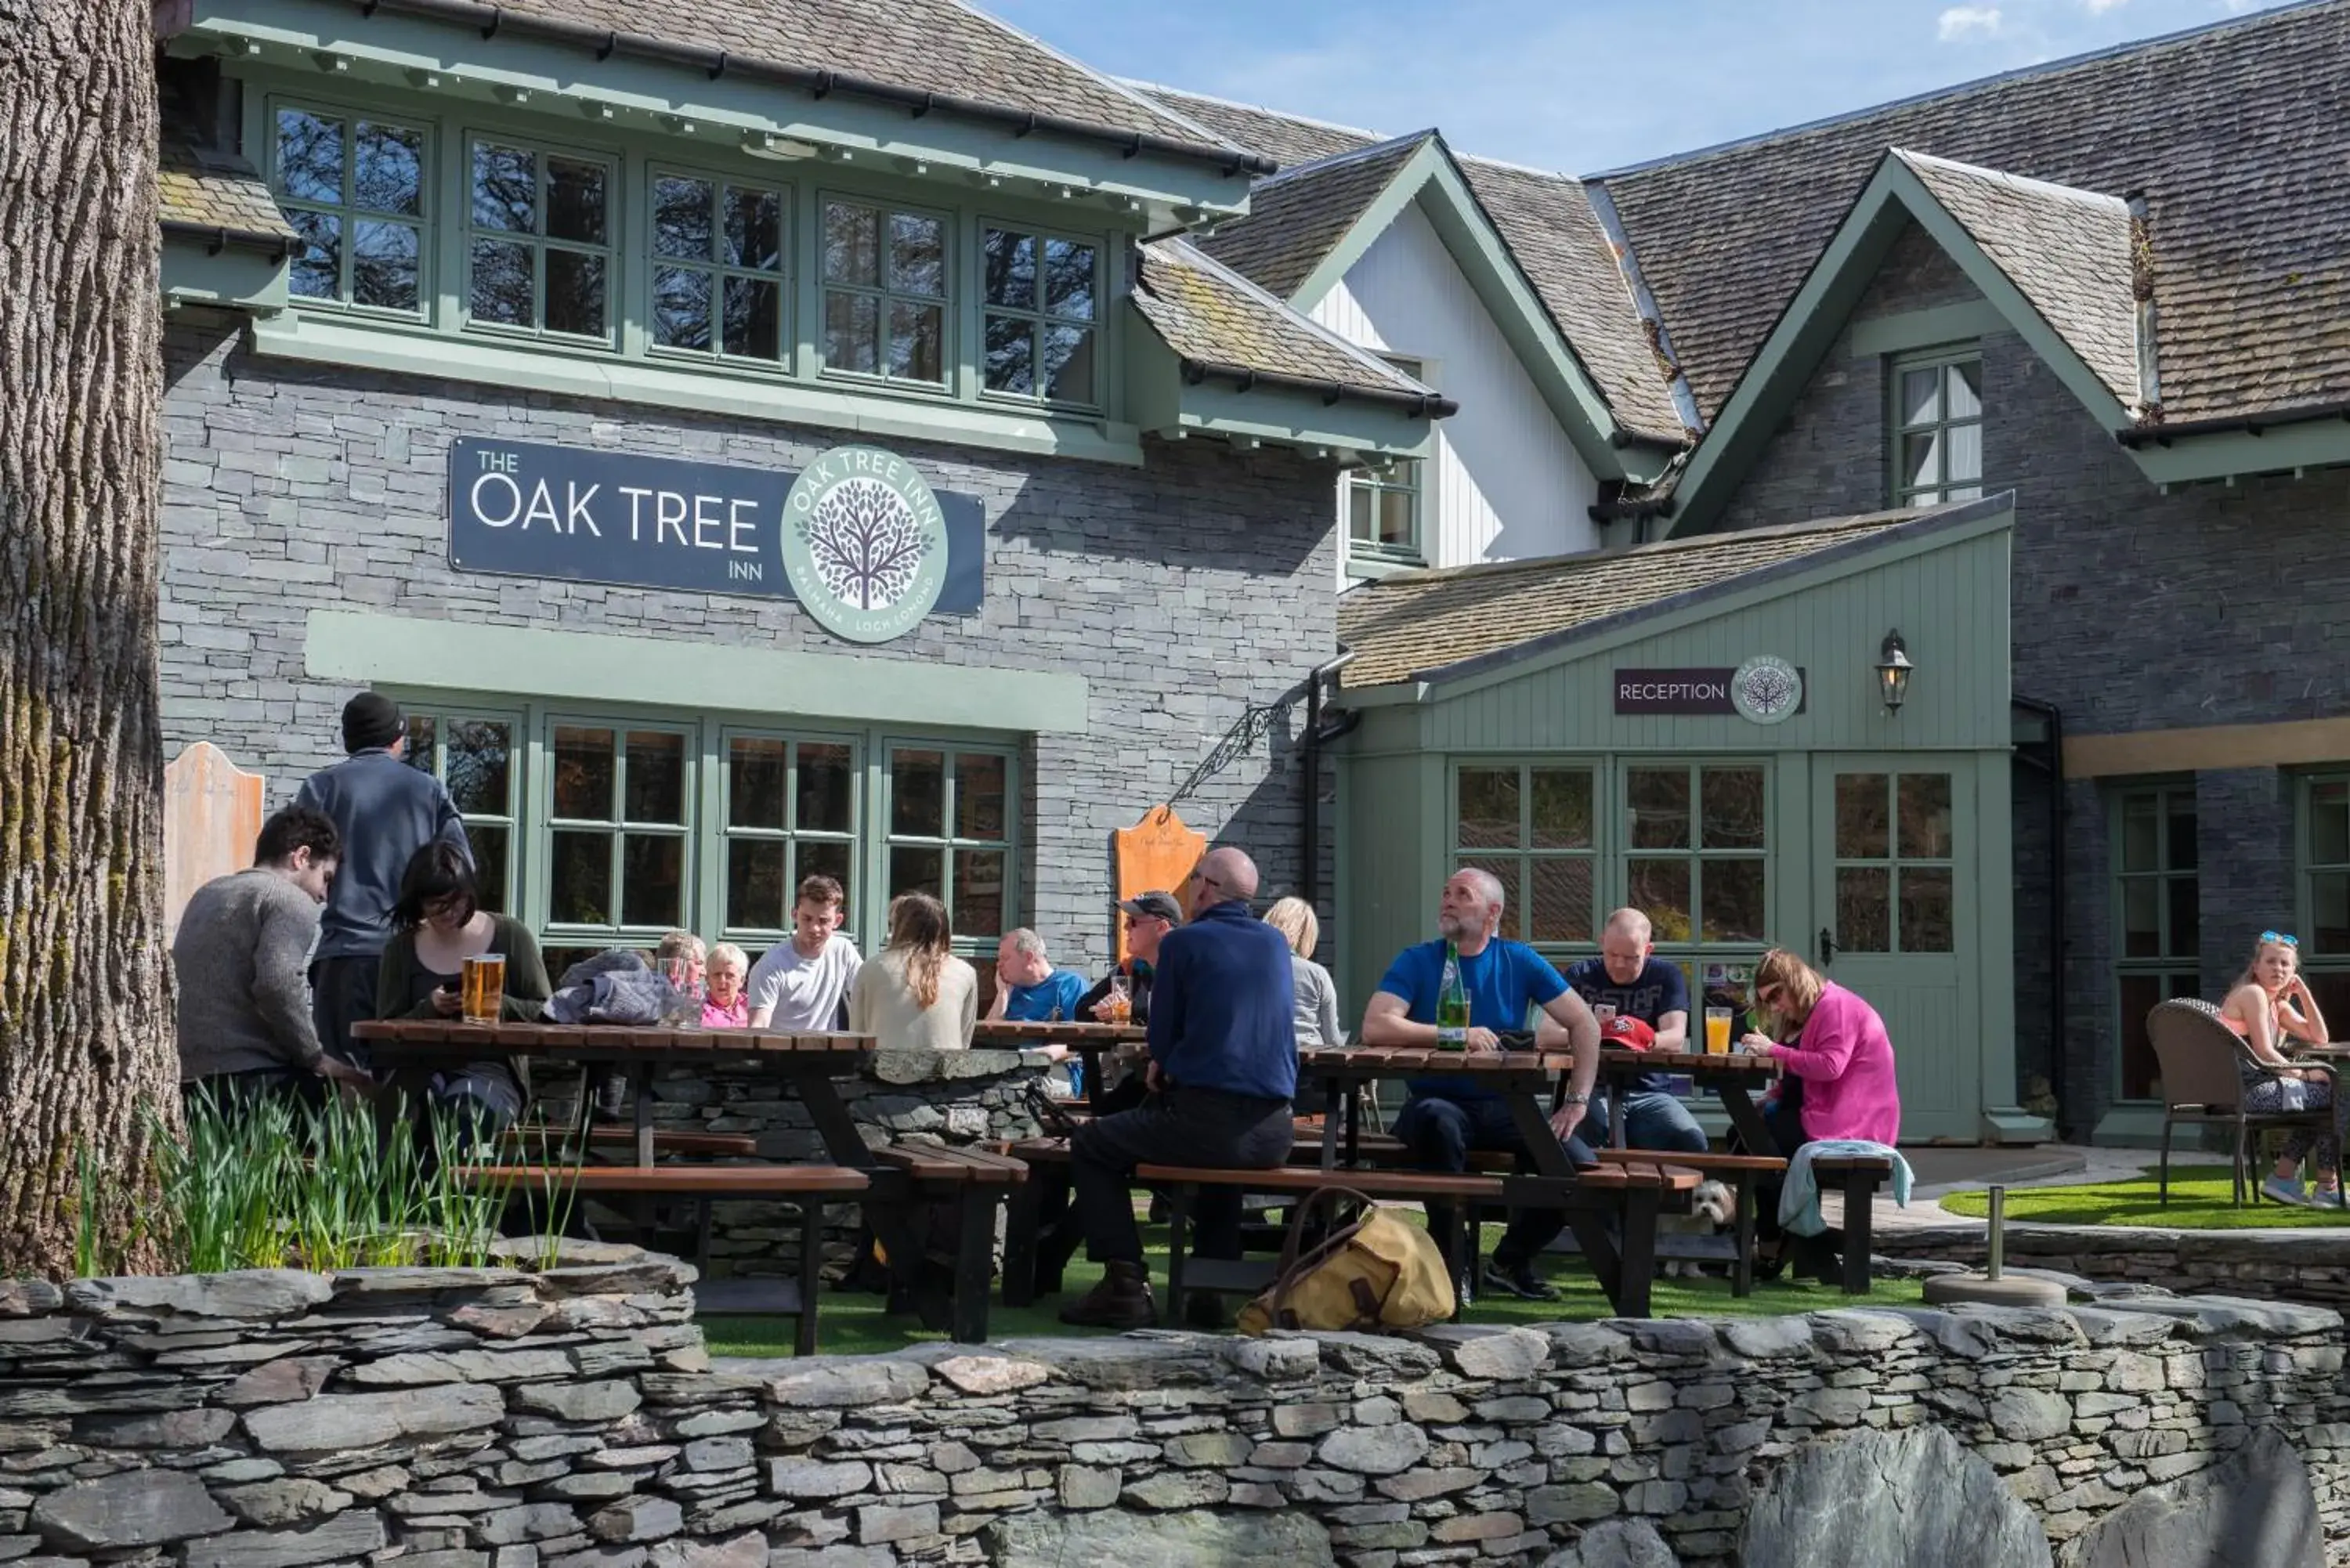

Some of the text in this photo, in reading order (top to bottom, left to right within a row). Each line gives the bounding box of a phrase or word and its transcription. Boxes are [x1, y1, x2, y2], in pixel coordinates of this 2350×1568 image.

[476, 450, 520, 473] THE
[793, 450, 939, 526] OAK TREE INN
[472, 472, 759, 552] OAK TREE
[728, 559, 762, 581] INN
[795, 565, 934, 632] BALMAHA LOCH LOMOND
[1620, 683, 1725, 699] RECEPTION
